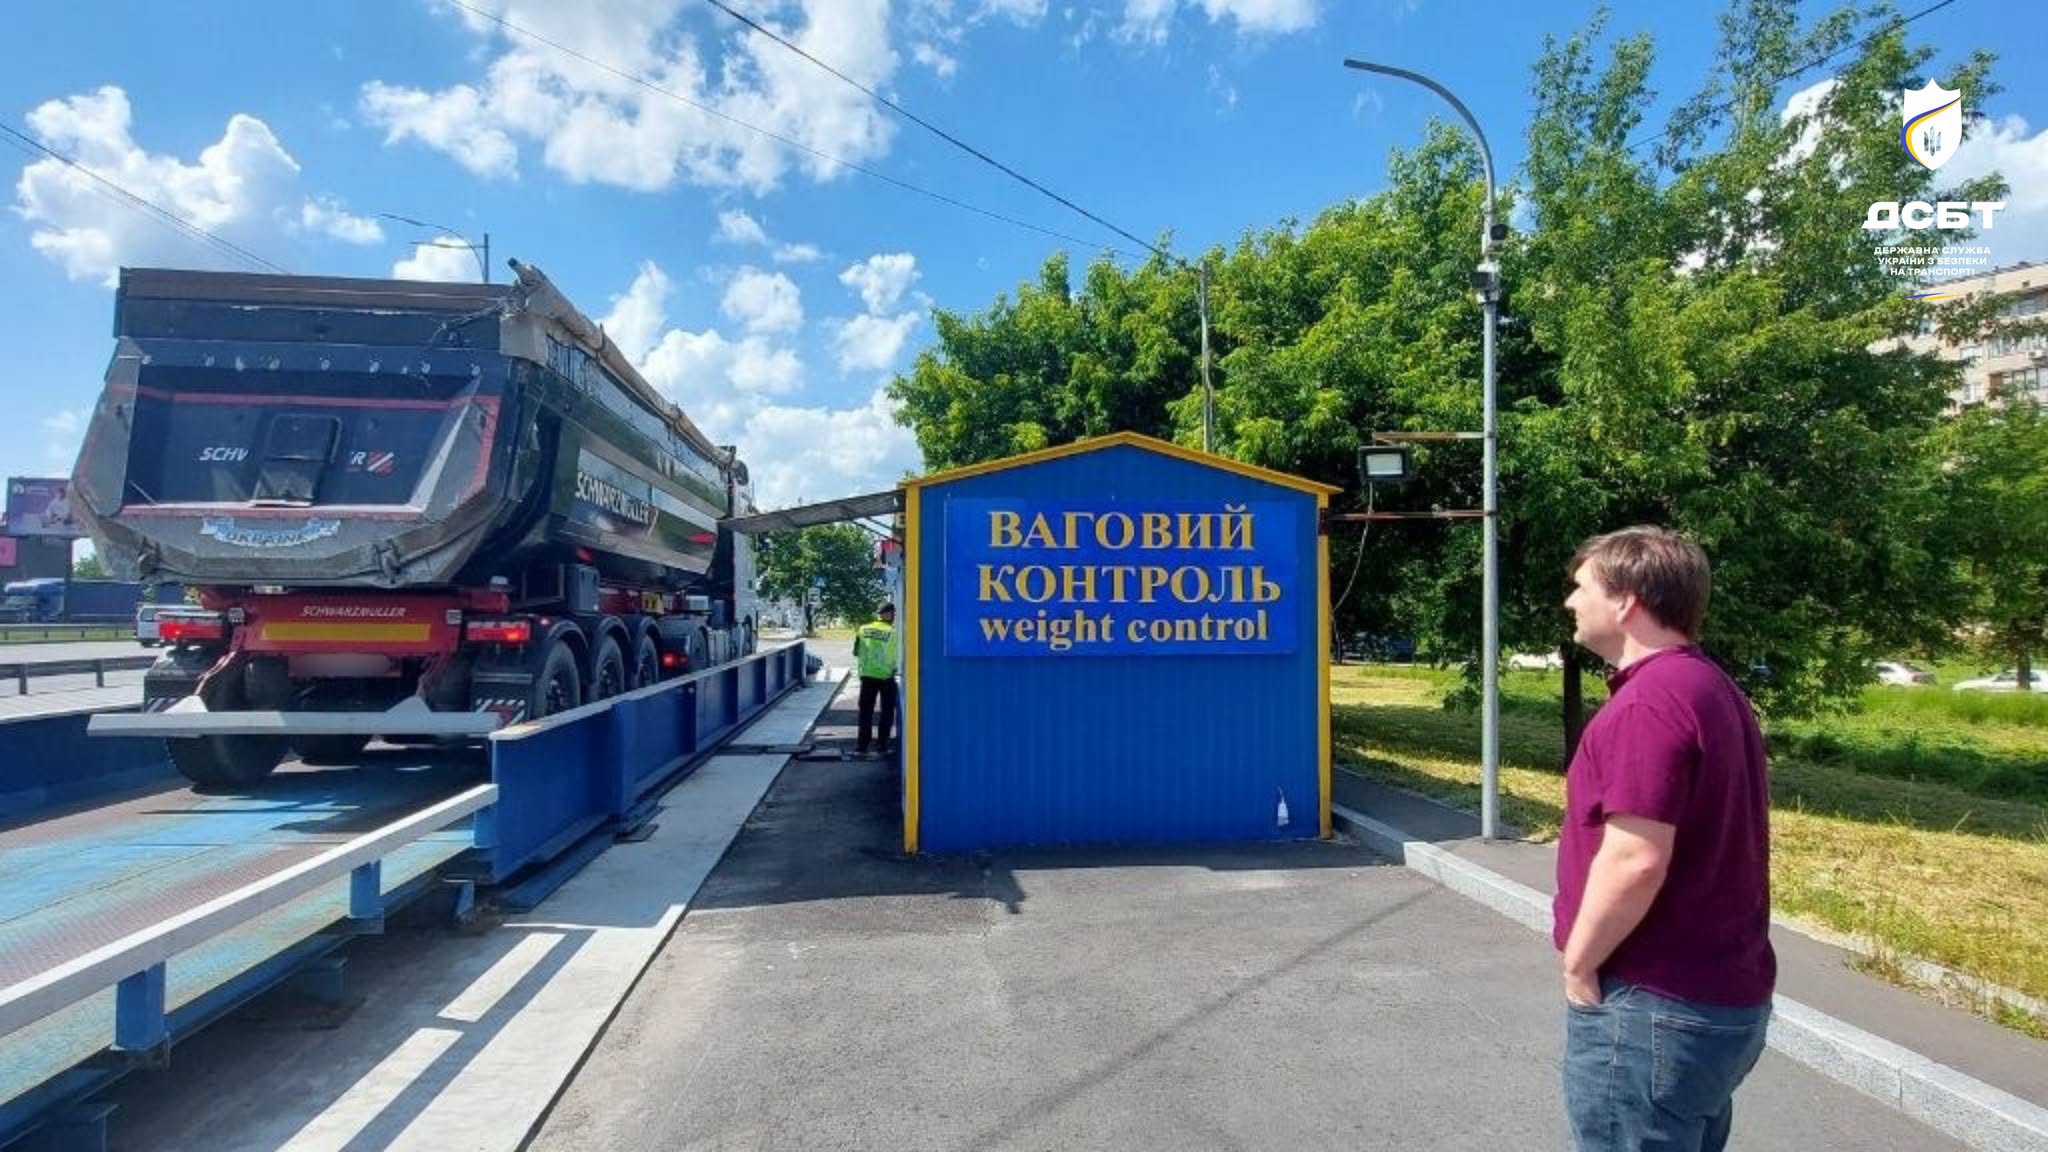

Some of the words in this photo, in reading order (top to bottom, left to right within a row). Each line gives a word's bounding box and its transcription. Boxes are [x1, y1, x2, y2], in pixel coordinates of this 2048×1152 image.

[987, 503, 1255, 549] ВАГОВИЙ
[976, 563, 1282, 603] КОНТРОЛЬ
[979, 610, 1115, 651] weight
[1127, 609, 1268, 642] control
